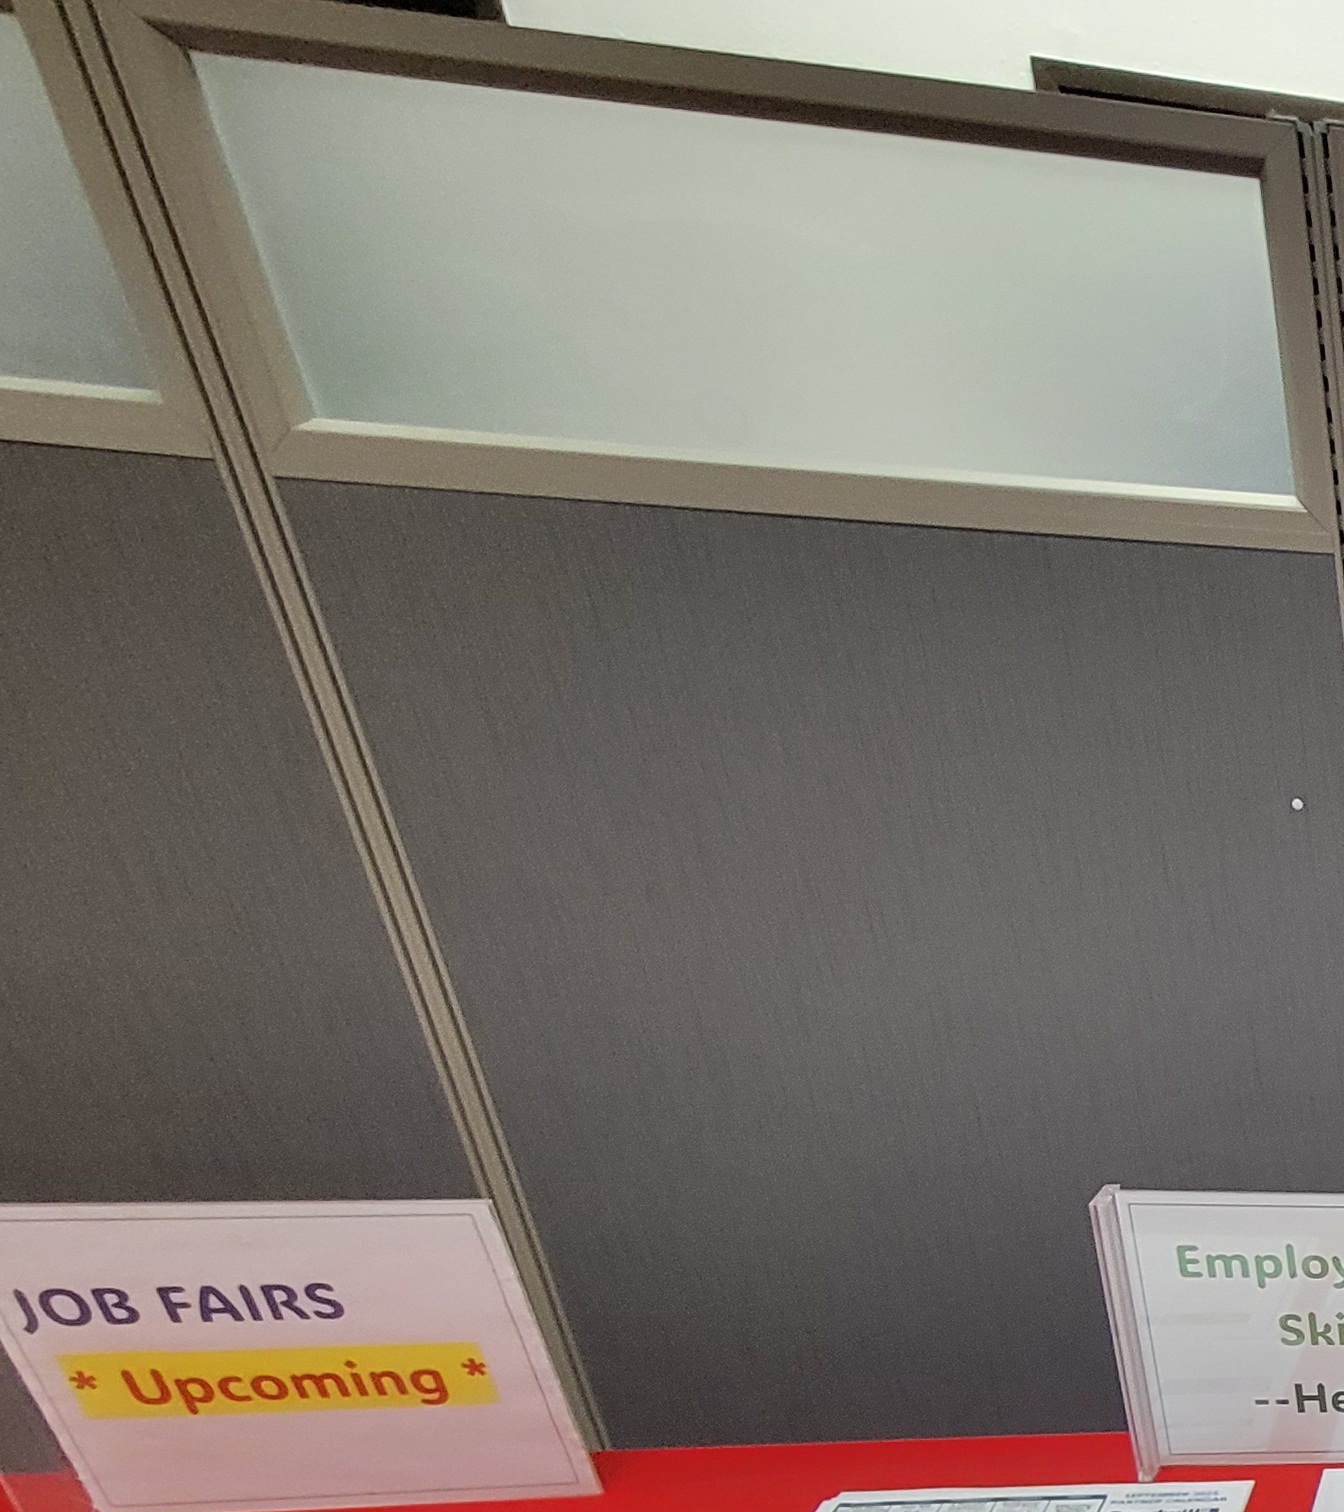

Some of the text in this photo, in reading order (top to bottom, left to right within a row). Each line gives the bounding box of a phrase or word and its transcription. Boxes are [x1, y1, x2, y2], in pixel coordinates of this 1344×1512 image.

[14, 1282, 346, 1334] JOB FAIRS
[121, 1360, 449, 1415] Upcoming
